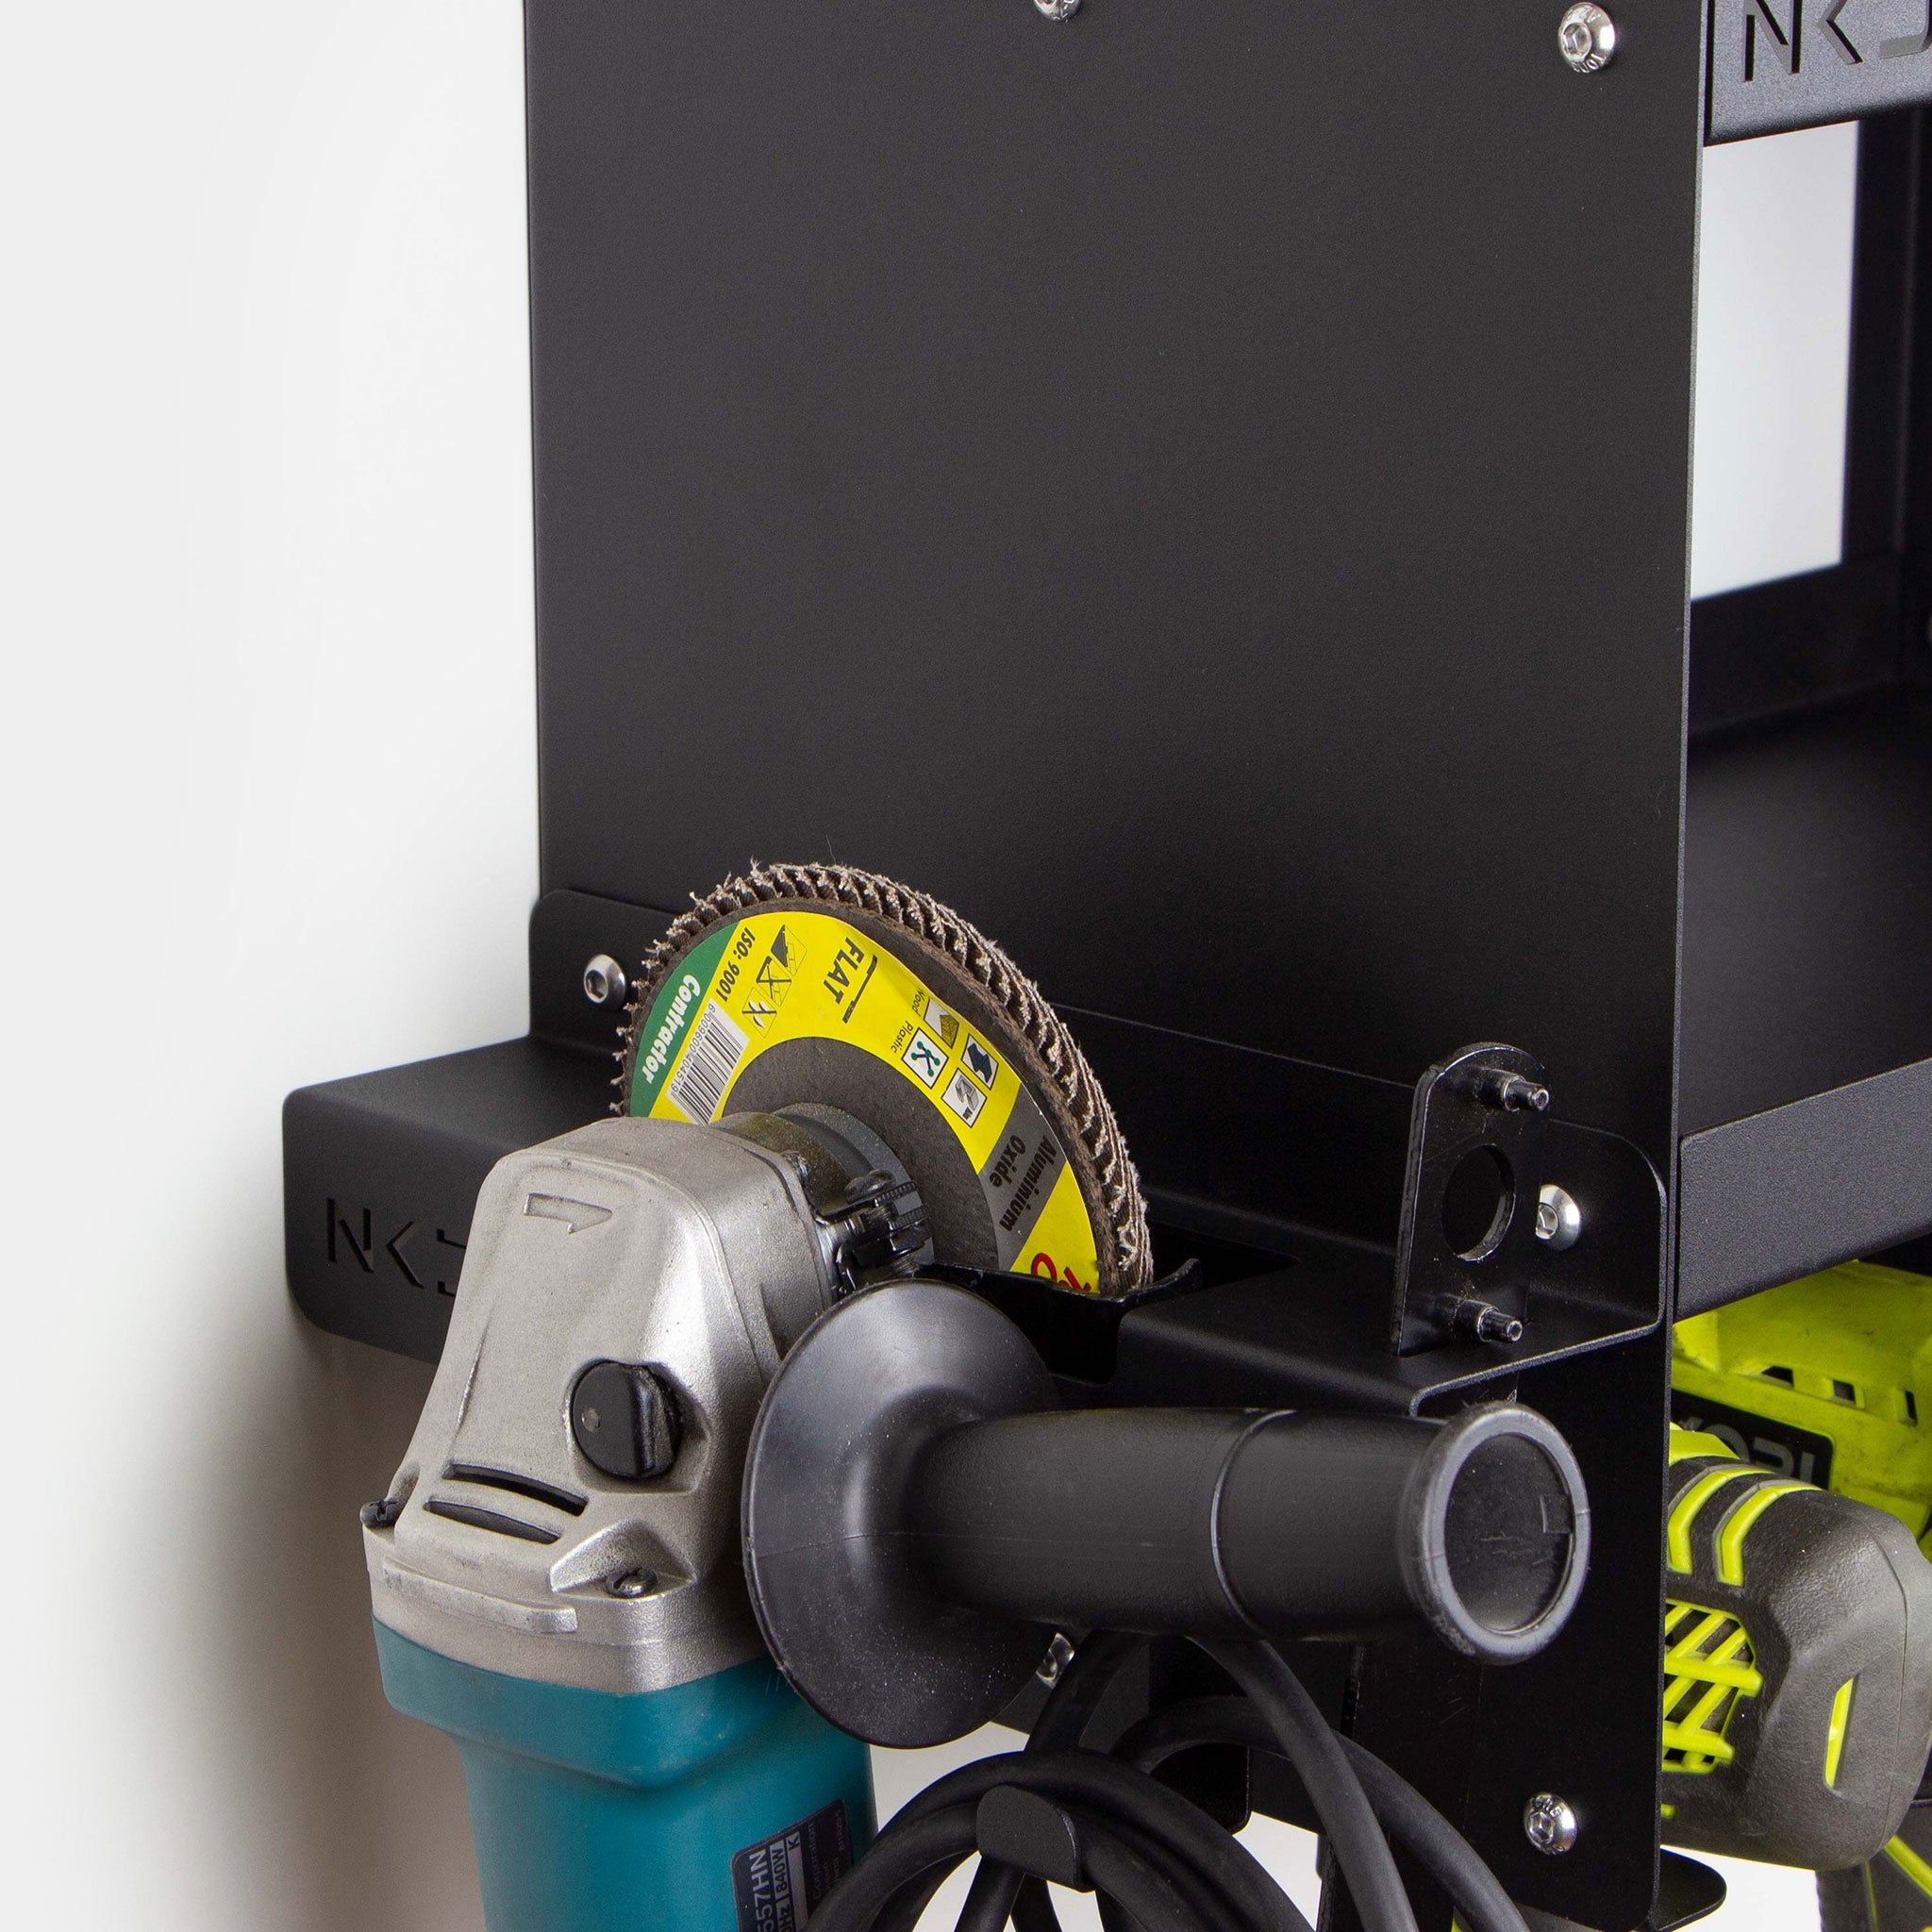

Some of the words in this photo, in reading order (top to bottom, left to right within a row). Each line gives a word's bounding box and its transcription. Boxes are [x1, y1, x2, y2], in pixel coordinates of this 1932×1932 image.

[733, 926, 756, 960] ISO:
[715, 960, 741, 1002] 9001
[823, 937, 865, 1005] FLAT
[911, 988, 926, 1017] Wood
[641, 974, 701, 1084] Contractor
[691, 1012, 711, 1055] 009600
[890, 1020, 914, 1054] Plastic
[671, 1053, 693, 1093] 404519
[989, 1134, 1026, 1188] Oxide
[999, 1135, 1058, 1232] Aluminium
[771, 1846, 788, 1894] 840W
